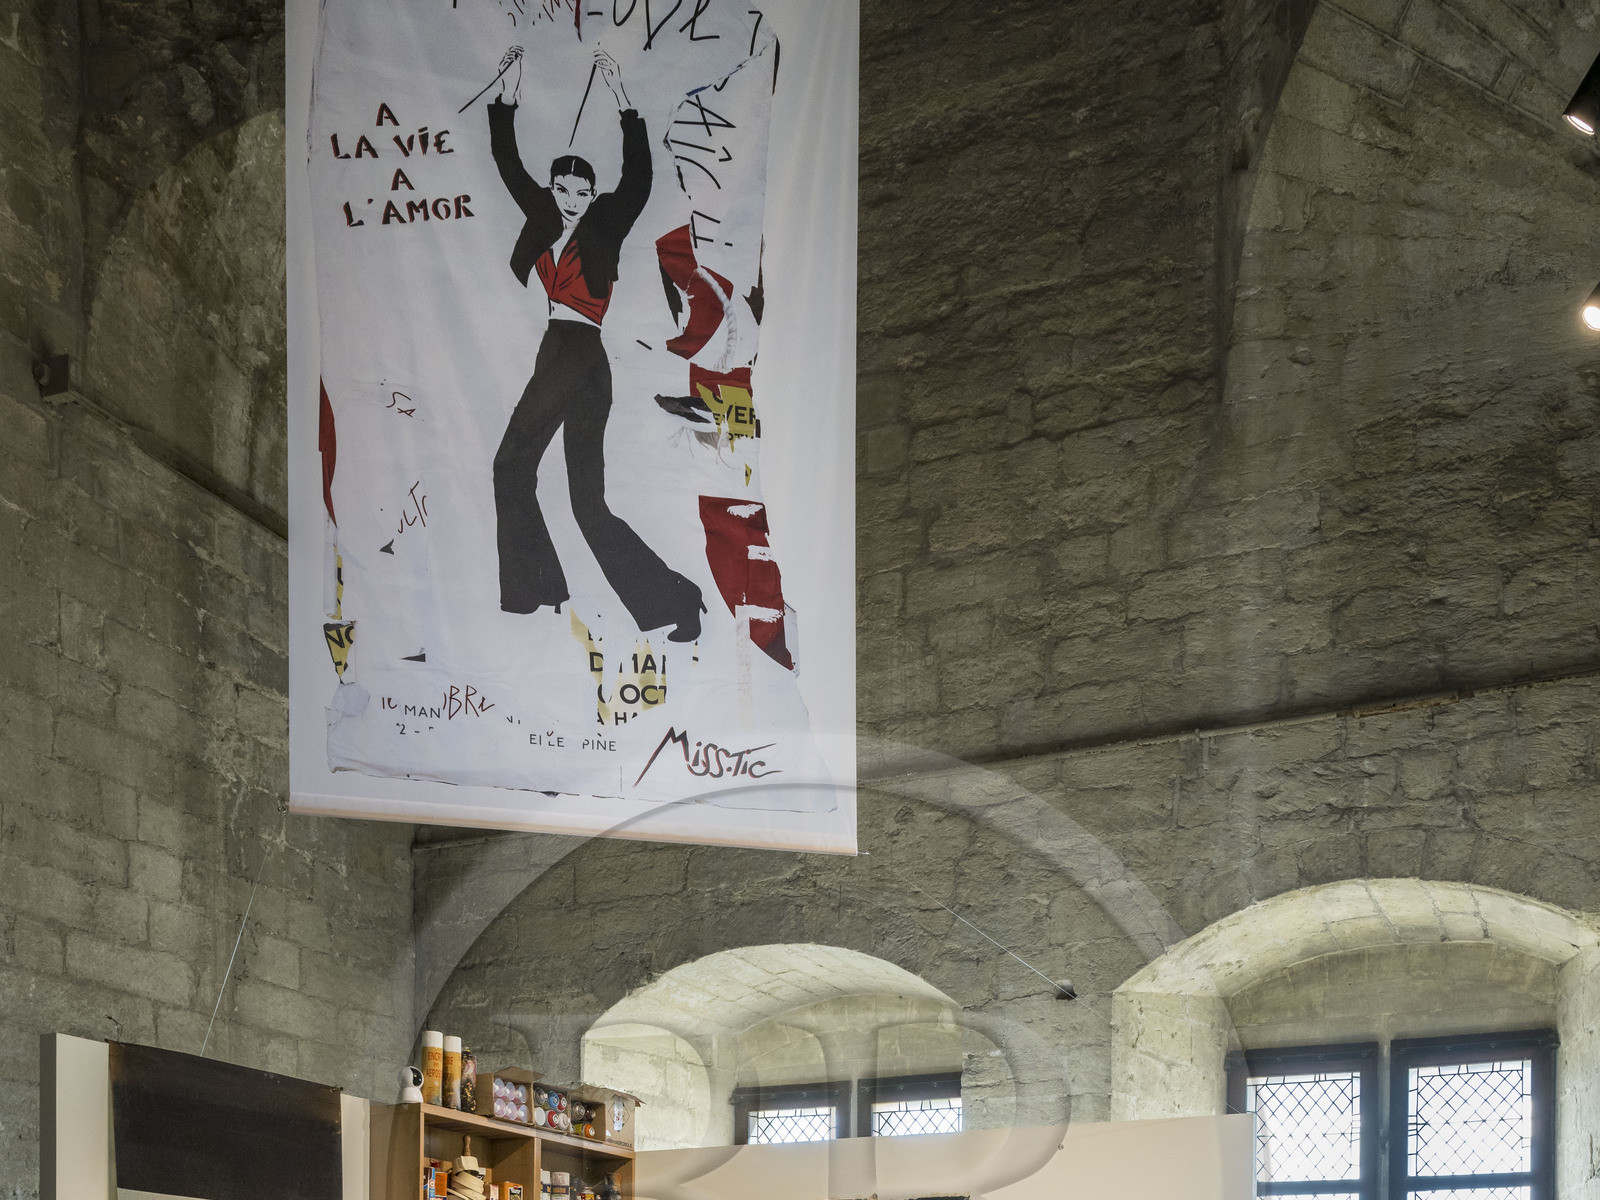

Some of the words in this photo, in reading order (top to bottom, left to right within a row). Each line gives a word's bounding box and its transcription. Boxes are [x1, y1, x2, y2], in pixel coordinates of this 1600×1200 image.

[376, 103, 400, 126] A
[330, 133, 379, 159] LA
[391, 168, 415, 191] A
